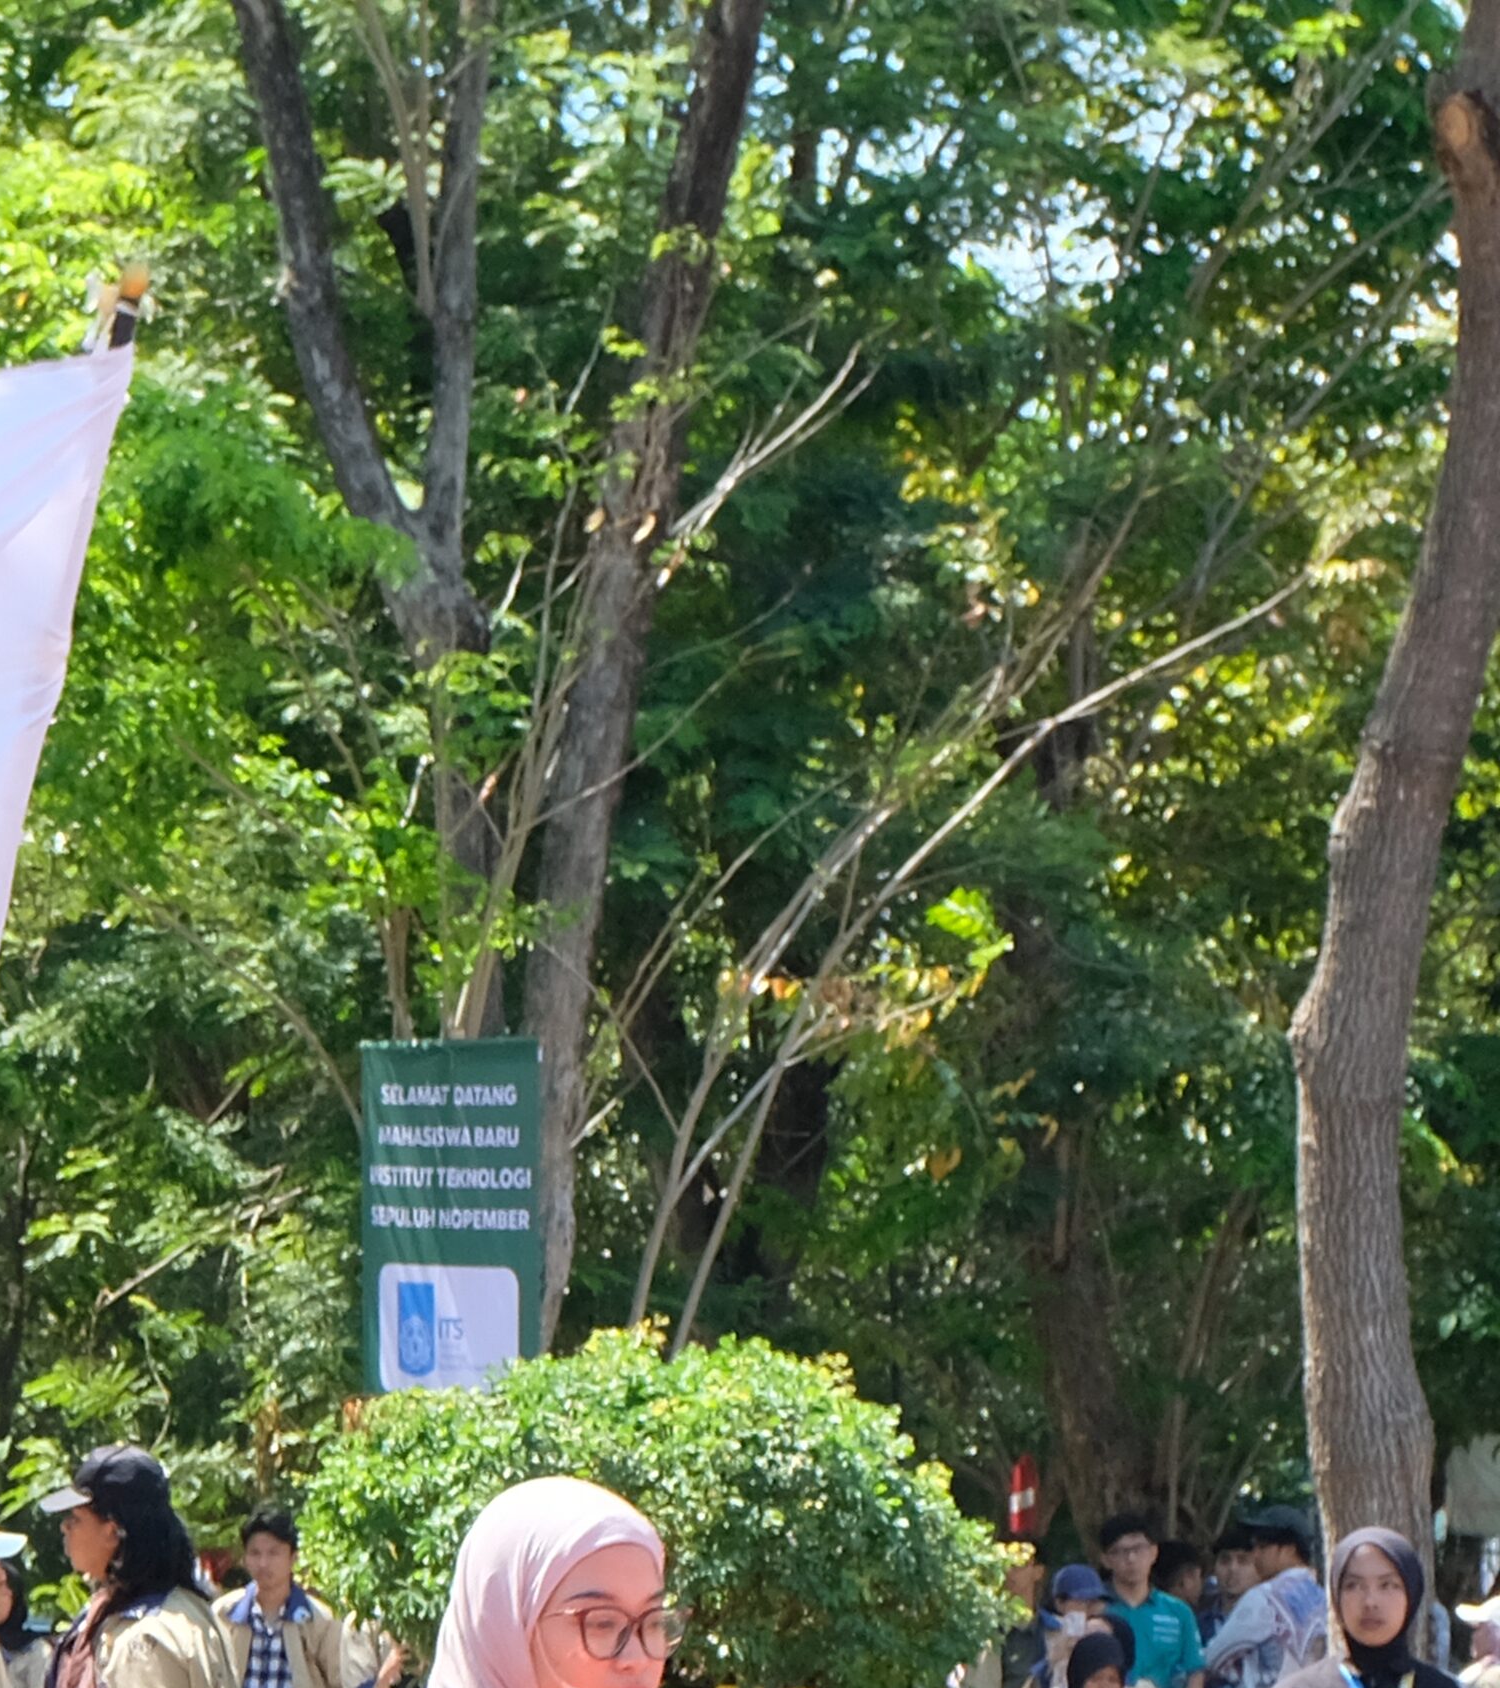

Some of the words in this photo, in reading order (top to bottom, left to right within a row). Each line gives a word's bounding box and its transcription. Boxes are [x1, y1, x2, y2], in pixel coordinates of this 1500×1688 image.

[380, 1082, 450, 1106] SELAMAT
[453, 1083, 518, 1107] DATANG
[377, 1125, 474, 1148] MAHASISWA
[474, 1125, 520, 1148] BARU
[369, 1164, 434, 1188] INSTITUT
[437, 1165, 532, 1189] TEKNOLOGI
[371, 1204, 436, 1229] SEPULUH
[438, 1207, 531, 1231] NOPEMBER
[438, 1317, 464, 1340] ITS
